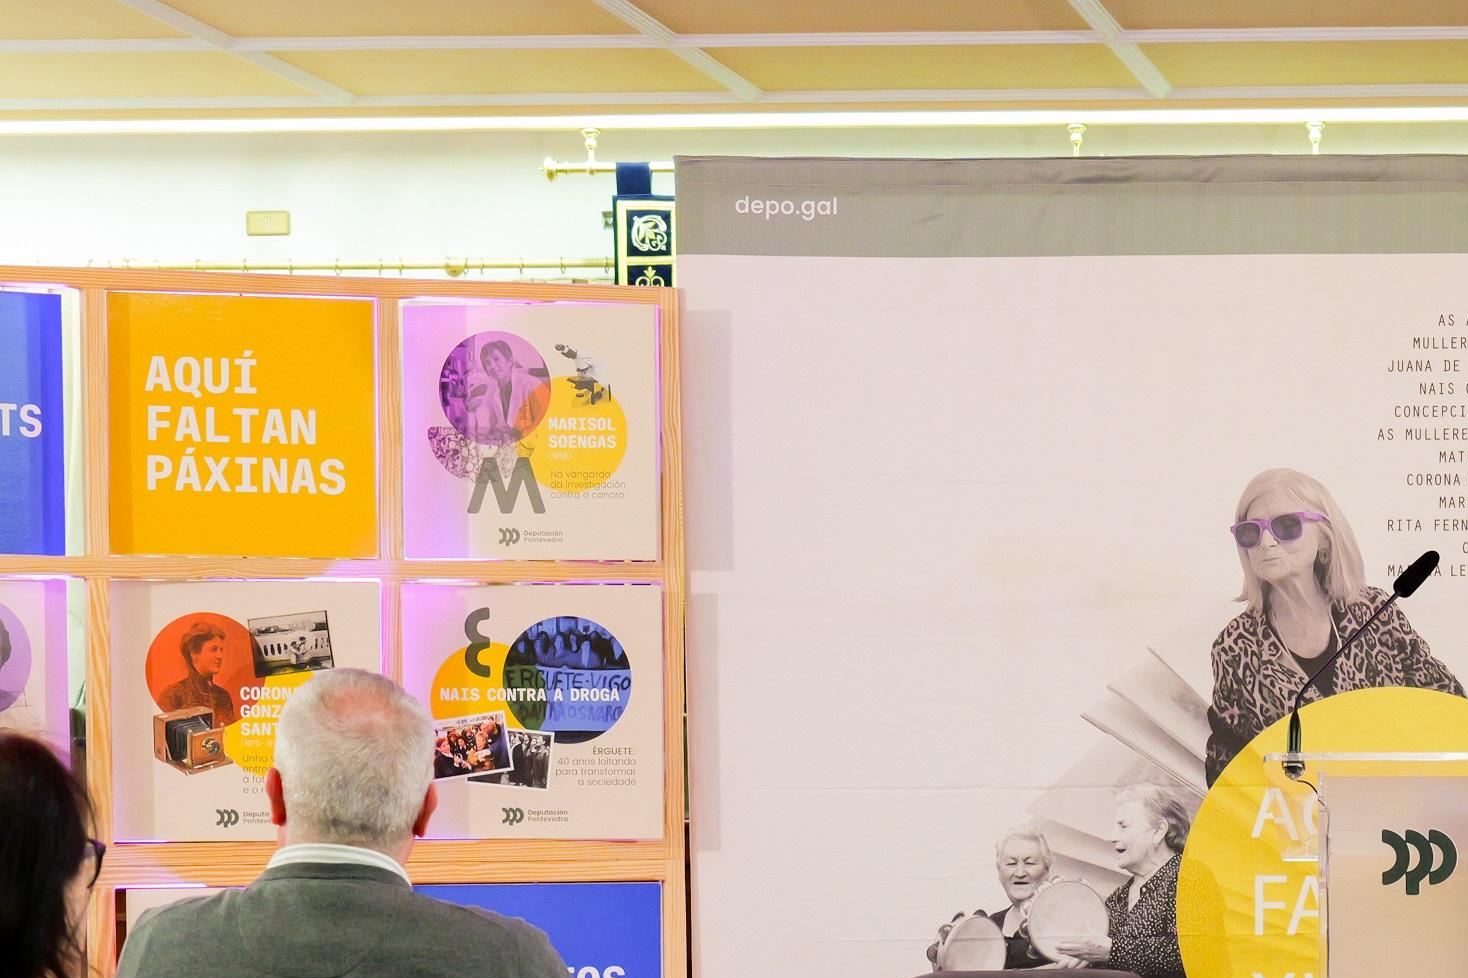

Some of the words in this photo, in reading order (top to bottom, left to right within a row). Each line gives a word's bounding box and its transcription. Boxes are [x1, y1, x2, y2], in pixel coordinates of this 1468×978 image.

[735, 196, 838, 221] depo.gal
[1438, 314, 1455, 326] AS
[1388, 360, 1432, 372] JUANA
[1444, 360, 1460, 372] DE
[145, 350, 257, 398] AQUÍ
[1419, 382, 1455, 395] NAIS
[147, 404, 317, 445] FALTAN
[548, 418, 616, 432] MARISOL
[1378, 428, 1394, 441] AS
[548, 434, 616, 448] SOENGAS
[147, 447, 347, 496] PÁXINAS
[566, 471, 611, 481] vangarda
[550, 480, 563, 489] da
[565, 480, 626, 491] investigación
[1407, 473, 1461, 486] CORONA
[550, 492, 580, 500] contra
[1388, 519, 1422, 532] RITA
[524, 530, 563, 538] Deputación
[440, 688, 480, 702] NAIS
[486, 688, 546, 702] CONTRA
[554, 688, 564, 702] A
[570, 688, 620, 702] DROGA
[592, 747, 636, 756] ÉRGUETE:
[242, 754, 268, 763] Unha
[558, 758, 570, 766] 40
[572, 758, 596, 766] anos
[598, 757, 636, 766] loitando
[556, 769, 578, 778] para
[580, 767, 636, 776] transformar
[587, 778, 636, 786] sociedade
[528, 809, 568, 817] Deputación
